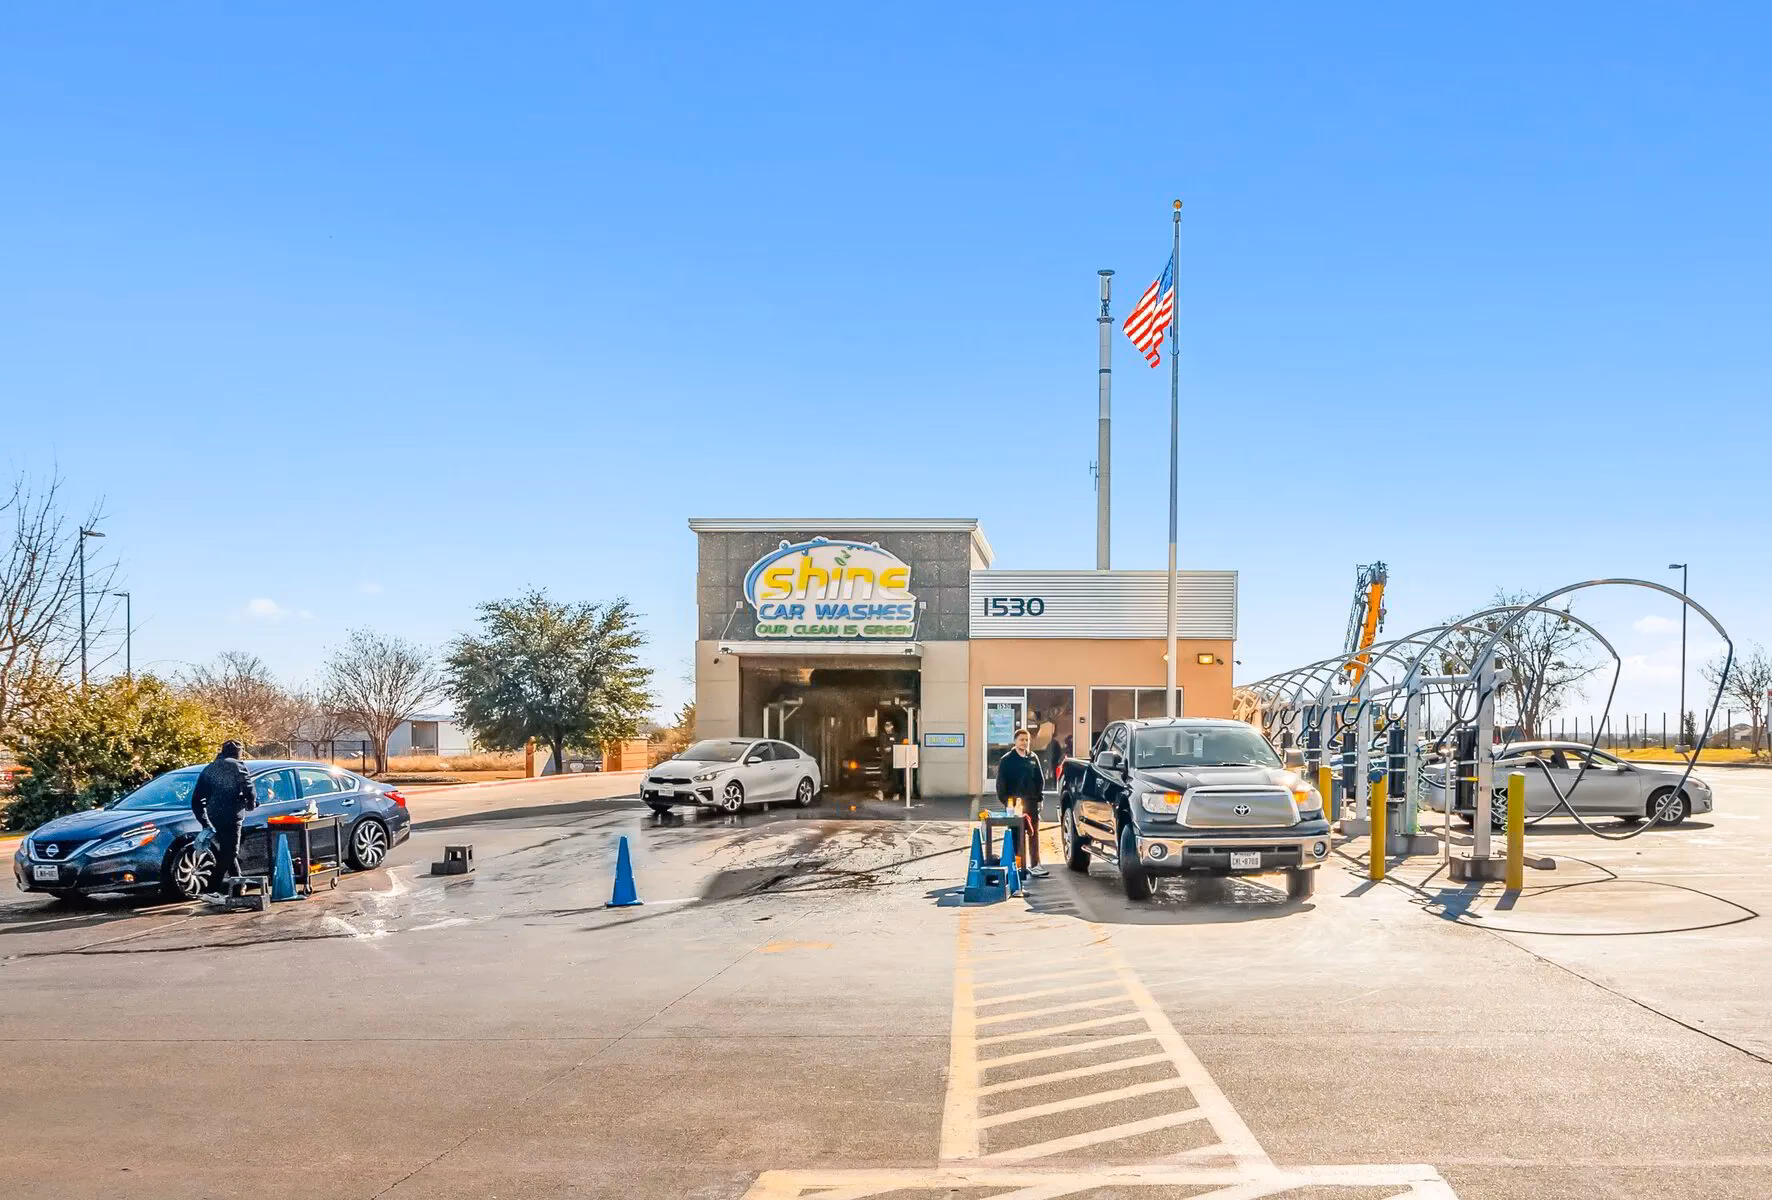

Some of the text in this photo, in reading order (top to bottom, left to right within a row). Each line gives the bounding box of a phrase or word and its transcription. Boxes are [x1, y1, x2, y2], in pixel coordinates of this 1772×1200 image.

[759, 604, 912, 621] CAR WASHES
[984, 598, 1044, 617] 1530
[757, 624, 912, 635] OUR CLEAN IS GREEN
